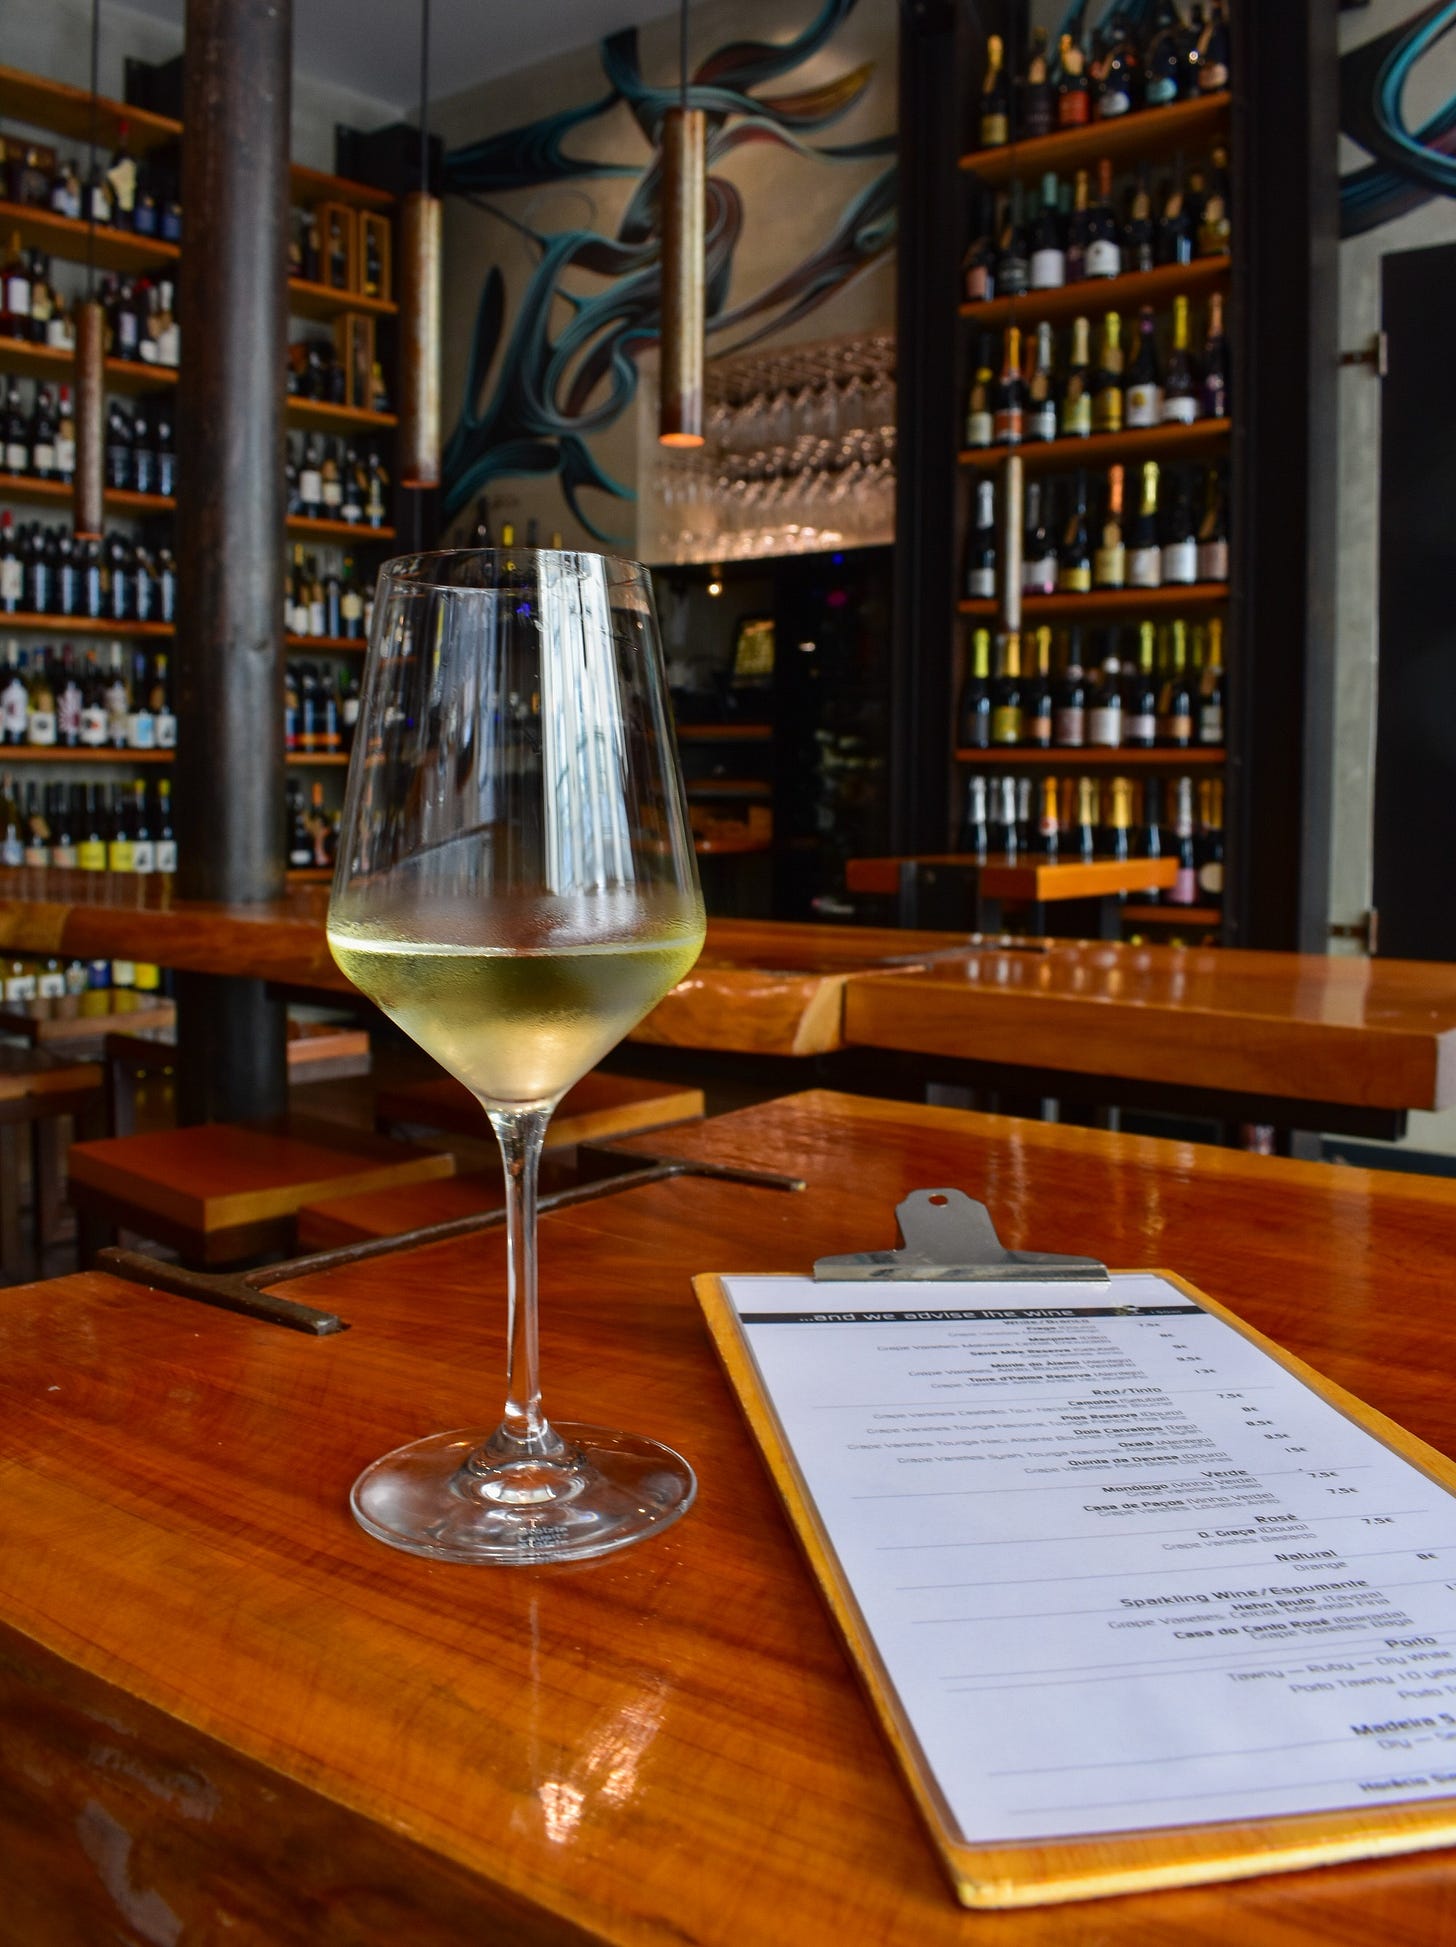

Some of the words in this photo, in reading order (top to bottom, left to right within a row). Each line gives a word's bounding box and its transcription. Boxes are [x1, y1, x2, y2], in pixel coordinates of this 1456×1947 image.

[863, 1312, 897, 1321] we
[903, 1310, 976, 1320] advise
[981, 1310, 1018, 1319] the
[1023, 1308, 1076, 1318] wine
[1102, 1484, 1169, 1492] Monólogo
[1214, 1477, 1257, 1485] Verde)
[1230, 1493, 1275, 1501] Verde)
[1254, 1514, 1298, 1523] Rosé
[1215, 1529, 1256, 1537] Graça
[1258, 1524, 1309, 1533] (Douro)
[1162, 1542, 1202, 1550] Grape
[1260, 1533, 1318, 1542] Bastardo
[1274, 1550, 1338, 1561] Natural
[1292, 1562, 1348, 1571] Orange
[1120, 1595, 1210, 1608] Sparkling
[1211, 1580, 1369, 1599] Wine/Espumante
[1231, 1603, 1274, 1611] Hehn
[1275, 1598, 1316, 1607] Bruto
[1107, 1620, 1155, 1629] Grape
[1280, 1600, 1354, 1613] Malvasia
[1351, 1597, 1390, 1606] Fina
[1173, 1630, 1214, 1639] Casa
[1241, 1624, 1288, 1633] Canto
[1289, 1618, 1331, 1628] Rosé
[1332, 1611, 1411, 1624] (Bairrada)
[1246, 1627, 1298, 1640] Grape
[1366, 1616, 1414, 1628] Baga
[1384, 1637, 1437, 1648] Porto
[1227, 1670, 1285, 1681] Tawny
[1306, 1663, 1355, 1673] Ruby
[1375, 1657, 1408, 1666] Dry
[1407, 1651, 1452, 1661] White
[1289, 1682, 1335, 1693] Porto
[1336, 1676, 1395, 1688] Tawny
[1398, 1671, 1422, 1680] 10
[1397, 1689, 1443, 1700] Porto
[1350, 1718, 1436, 1735] Madeira
